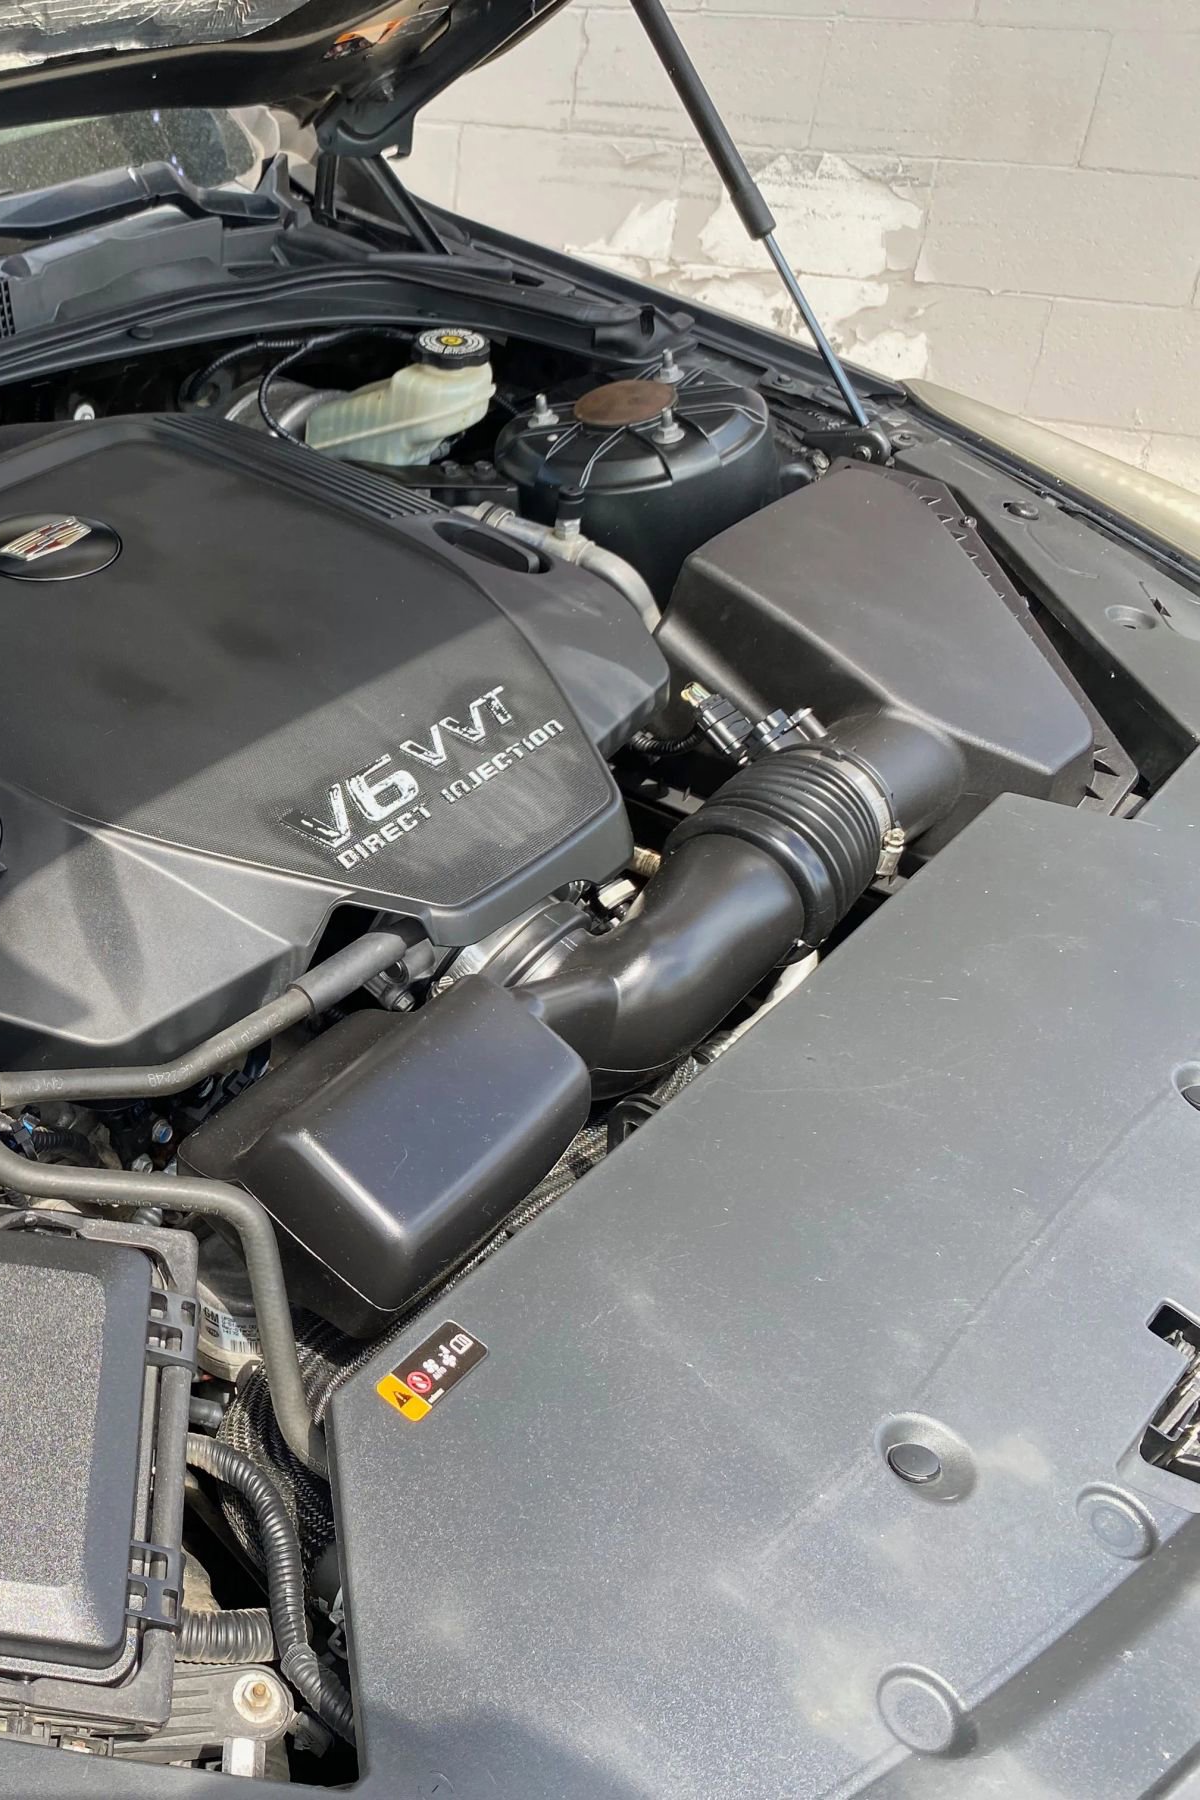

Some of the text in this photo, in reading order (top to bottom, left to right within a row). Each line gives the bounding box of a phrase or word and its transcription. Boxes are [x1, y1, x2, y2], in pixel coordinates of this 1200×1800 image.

[280, 685, 513, 848] V6 VVT
[336, 718, 564, 870] DIRECT INJECTION
